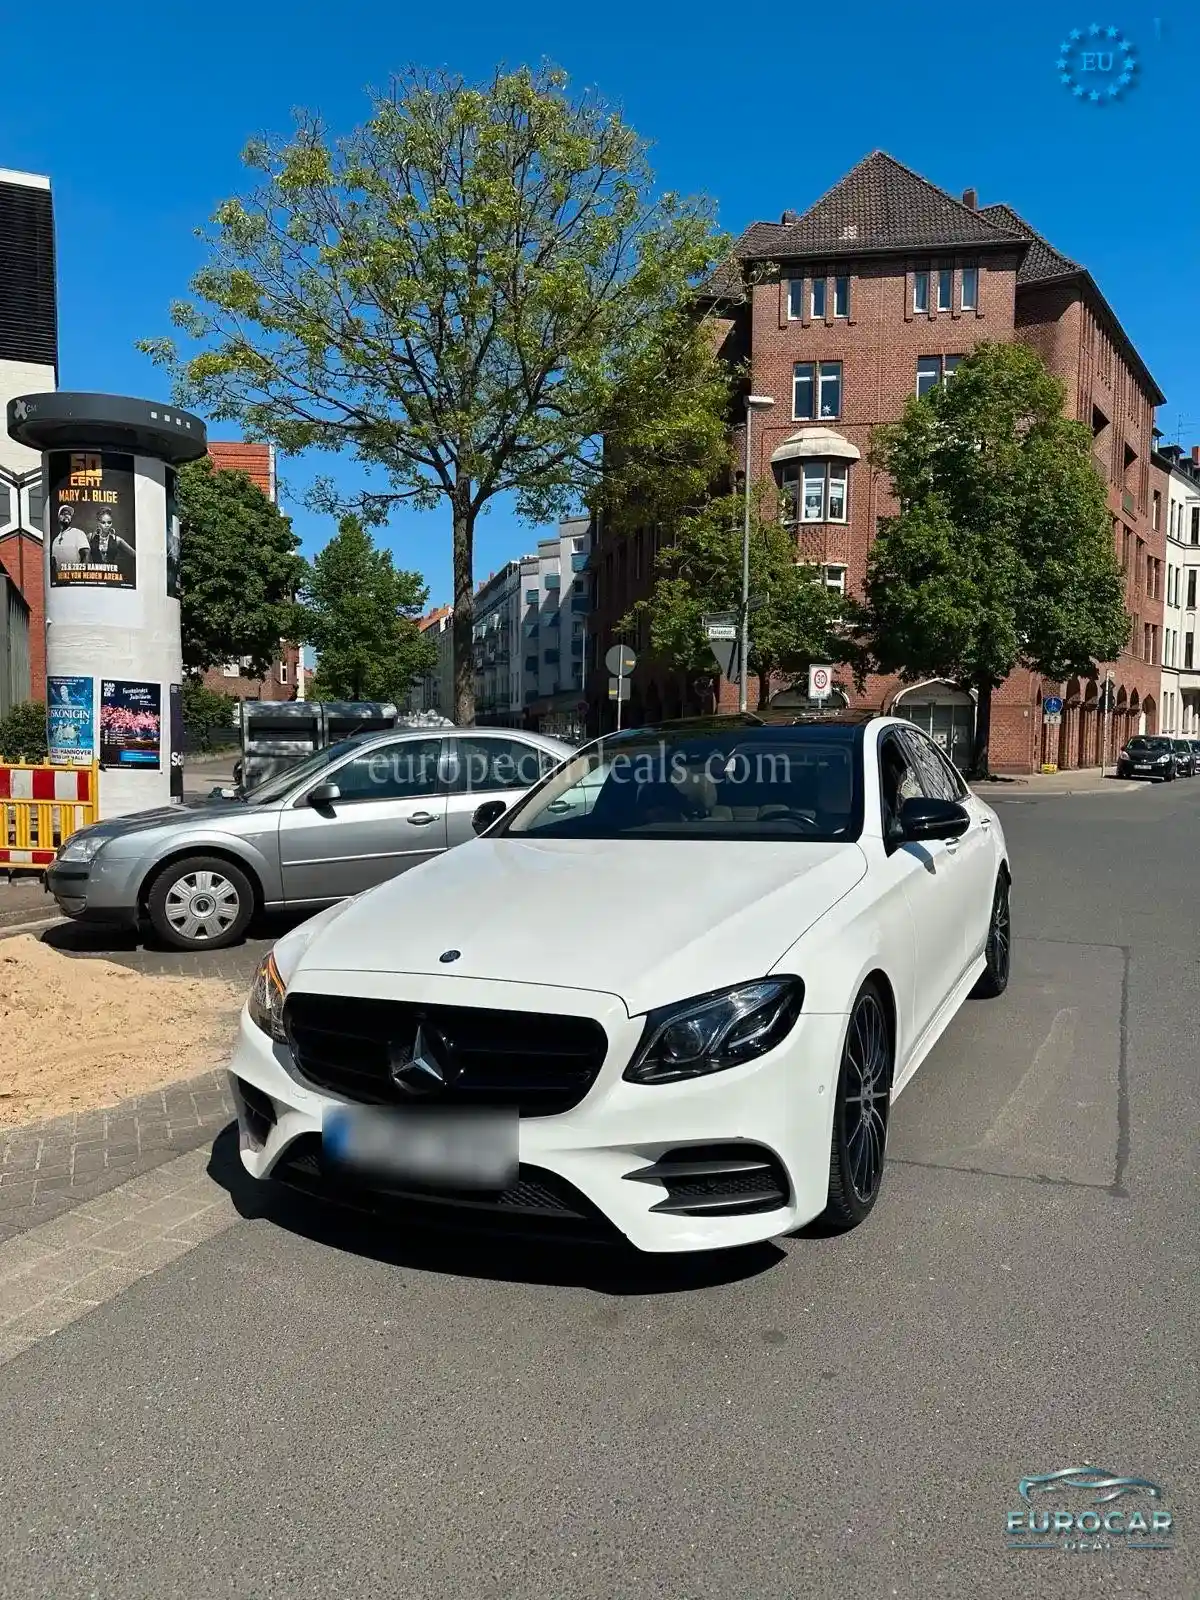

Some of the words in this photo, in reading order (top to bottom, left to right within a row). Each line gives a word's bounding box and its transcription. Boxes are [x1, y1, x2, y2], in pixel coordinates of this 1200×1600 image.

[71, 453, 103, 477] 50
[70, 476, 103, 487] CENT
[58, 489, 80, 502] MARY
[82, 490, 91, 502] J.
[92, 490, 118, 504] BLIGE
[87, 563, 118, 572] HANNOVER
[816, 674, 826, 684] 30
